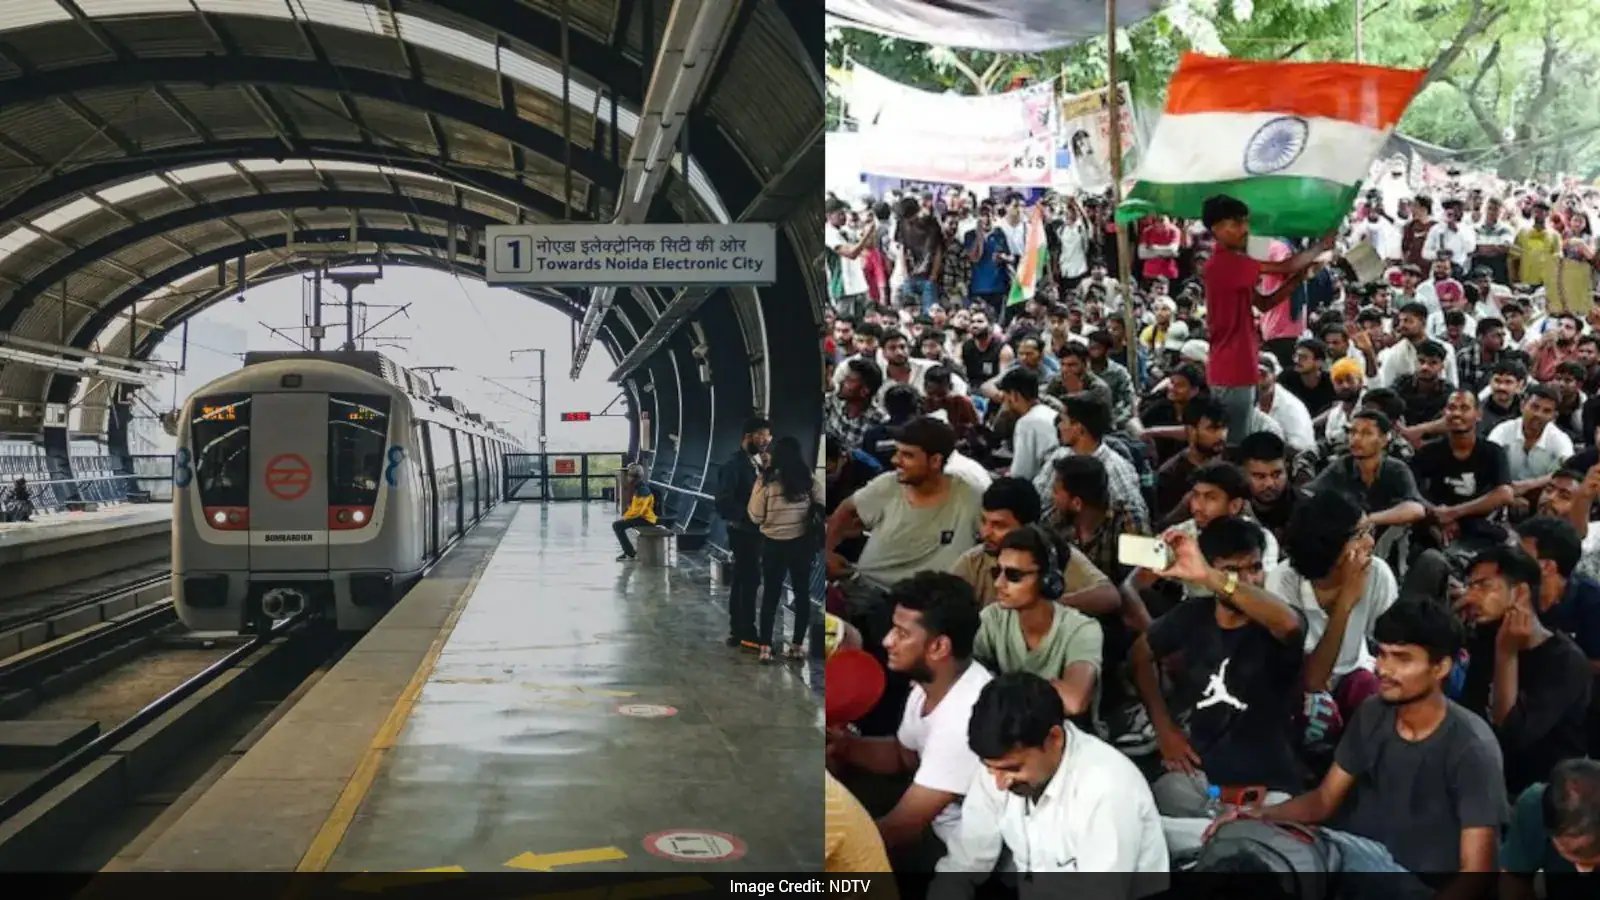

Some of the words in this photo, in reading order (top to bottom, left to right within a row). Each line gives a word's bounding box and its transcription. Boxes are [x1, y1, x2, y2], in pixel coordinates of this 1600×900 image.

[507, 240, 521, 268] 1
[536, 236, 576, 254] नोएडा
[661, 236, 691, 252] सिटी
[696, 235, 715, 252] की
[720, 235, 746, 252] ओर
[537, 257, 601, 270] Towards
[605, 257, 648, 270] Noida
[653, 257, 728, 270] Electronic
[732, 257, 763, 272] City
